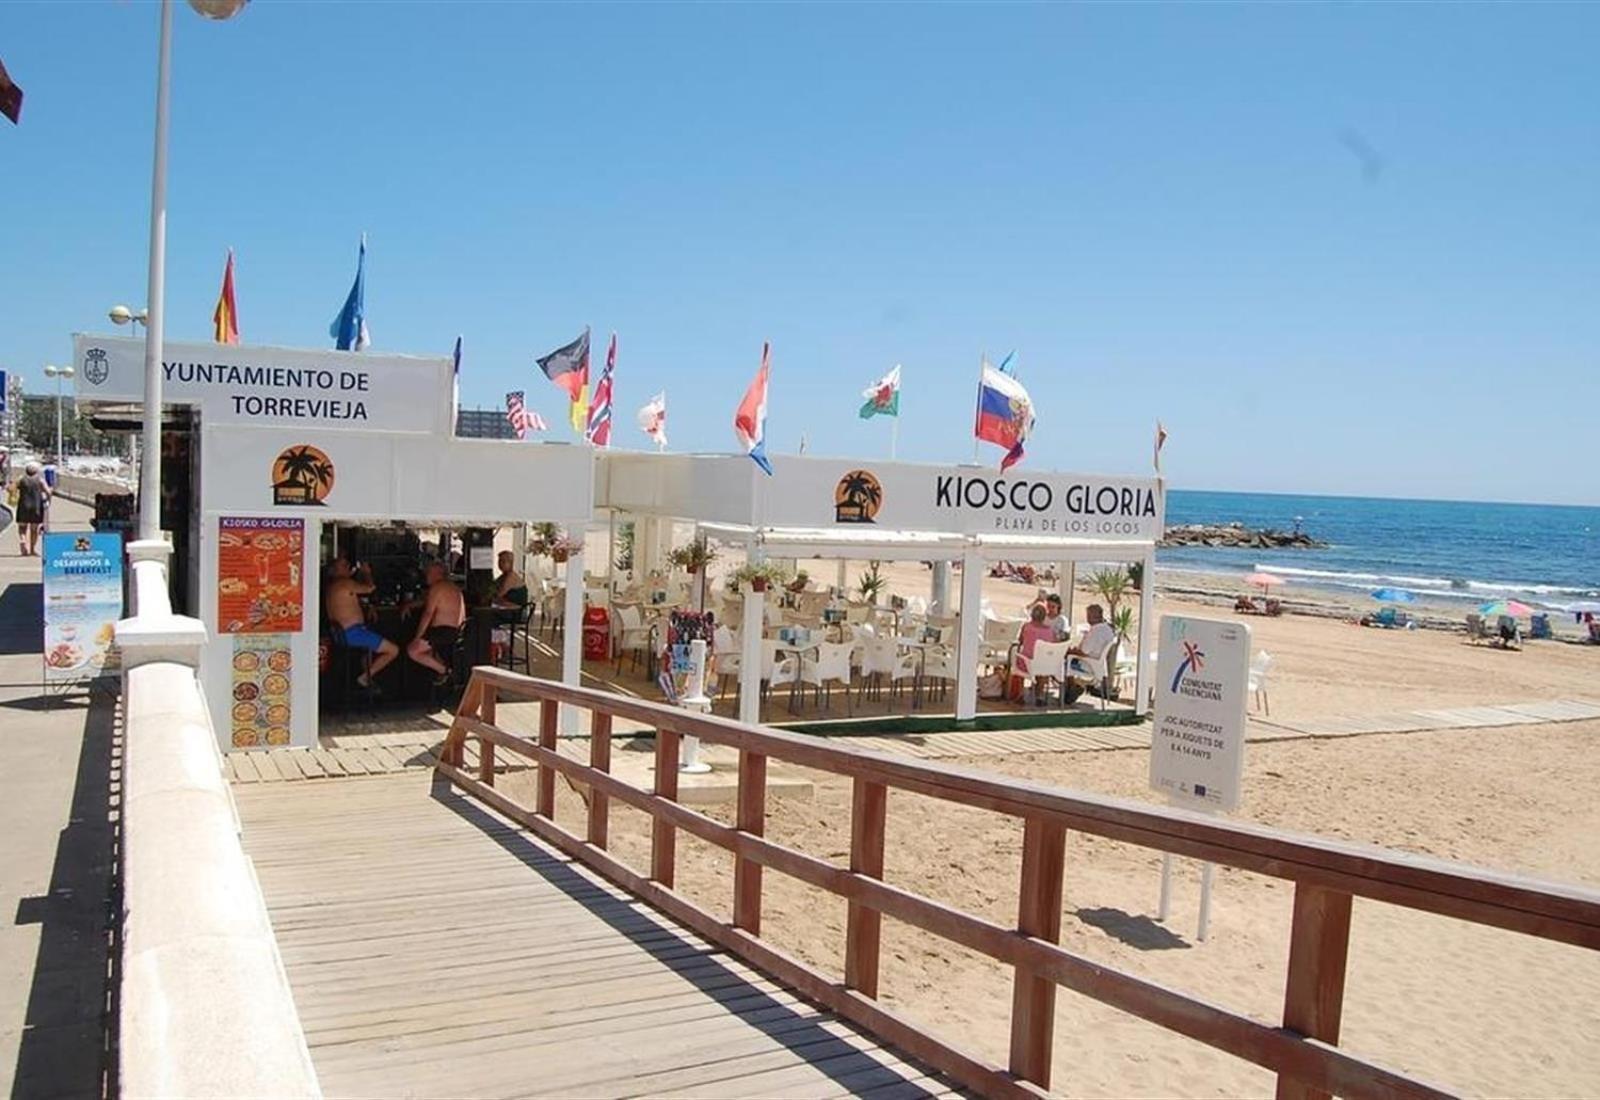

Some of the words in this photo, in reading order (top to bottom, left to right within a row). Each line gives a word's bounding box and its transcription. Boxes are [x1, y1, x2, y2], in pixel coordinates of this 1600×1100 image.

[162, 362, 333, 389] YUNTAMIENTO
[340, 372, 369, 391] DE
[232, 396, 368, 420] TORREVIEJA
[936, 476, 1053, 512] KIOSCO
[1066, 485, 1156, 517] GLORIA
[261, 519, 302, 528] GLORIA
[995, 517, 1033, 531] PLAYA
[1042, 519, 1057, 532] DE
[1064, 520, 1089, 533] LOS
[1096, 521, 1140, 535] LOCOS
[1182, 677, 1222, 691] COMUNITAT
[1181, 687, 1221, 700] VALENCIANA
[1179, 718, 1222, 733] AUTORITZAT
[1160, 727, 1174, 737] PER
[1214, 739, 1224, 749] DE
